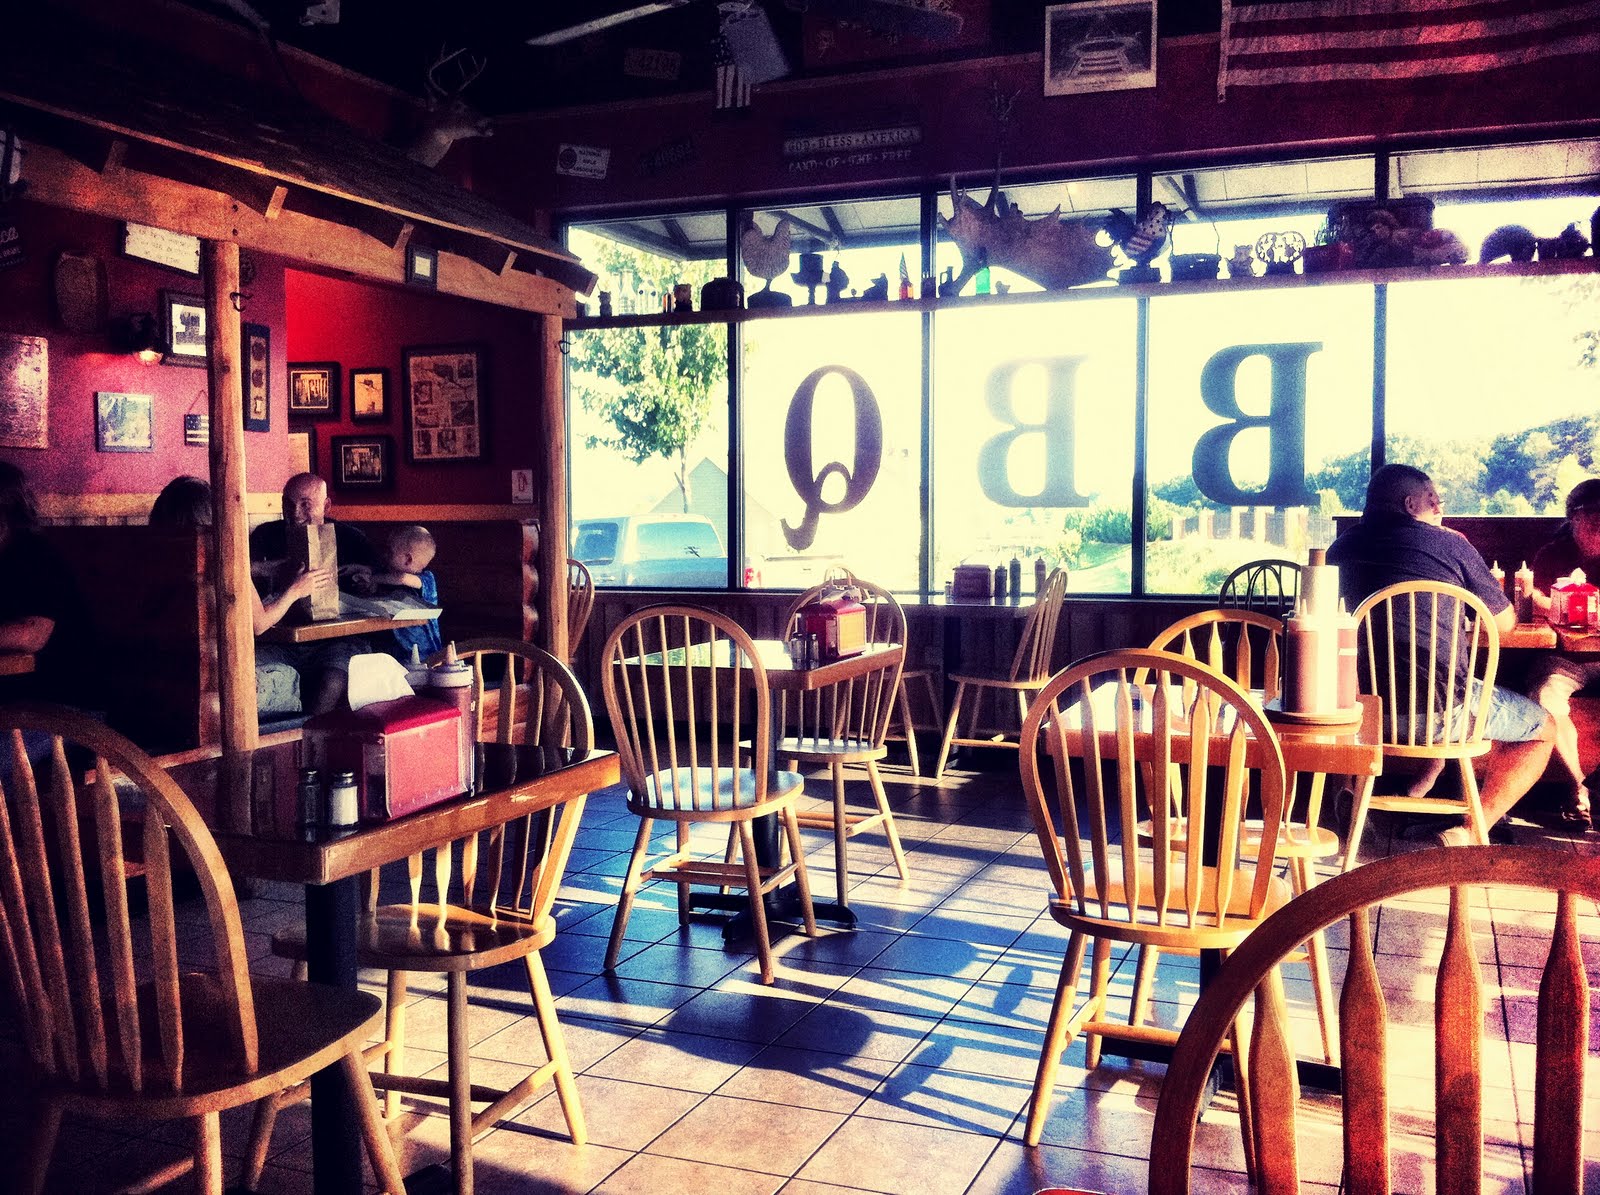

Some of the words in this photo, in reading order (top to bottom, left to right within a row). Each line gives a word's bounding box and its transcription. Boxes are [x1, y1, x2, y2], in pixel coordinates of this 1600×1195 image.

[819, 135, 852, 148] BLESS
[864, 128, 916, 145] AMERICA
[825, 155, 841, 168] OF
[848, 152, 873, 165] THE
[881, 148, 912, 161] FREE
